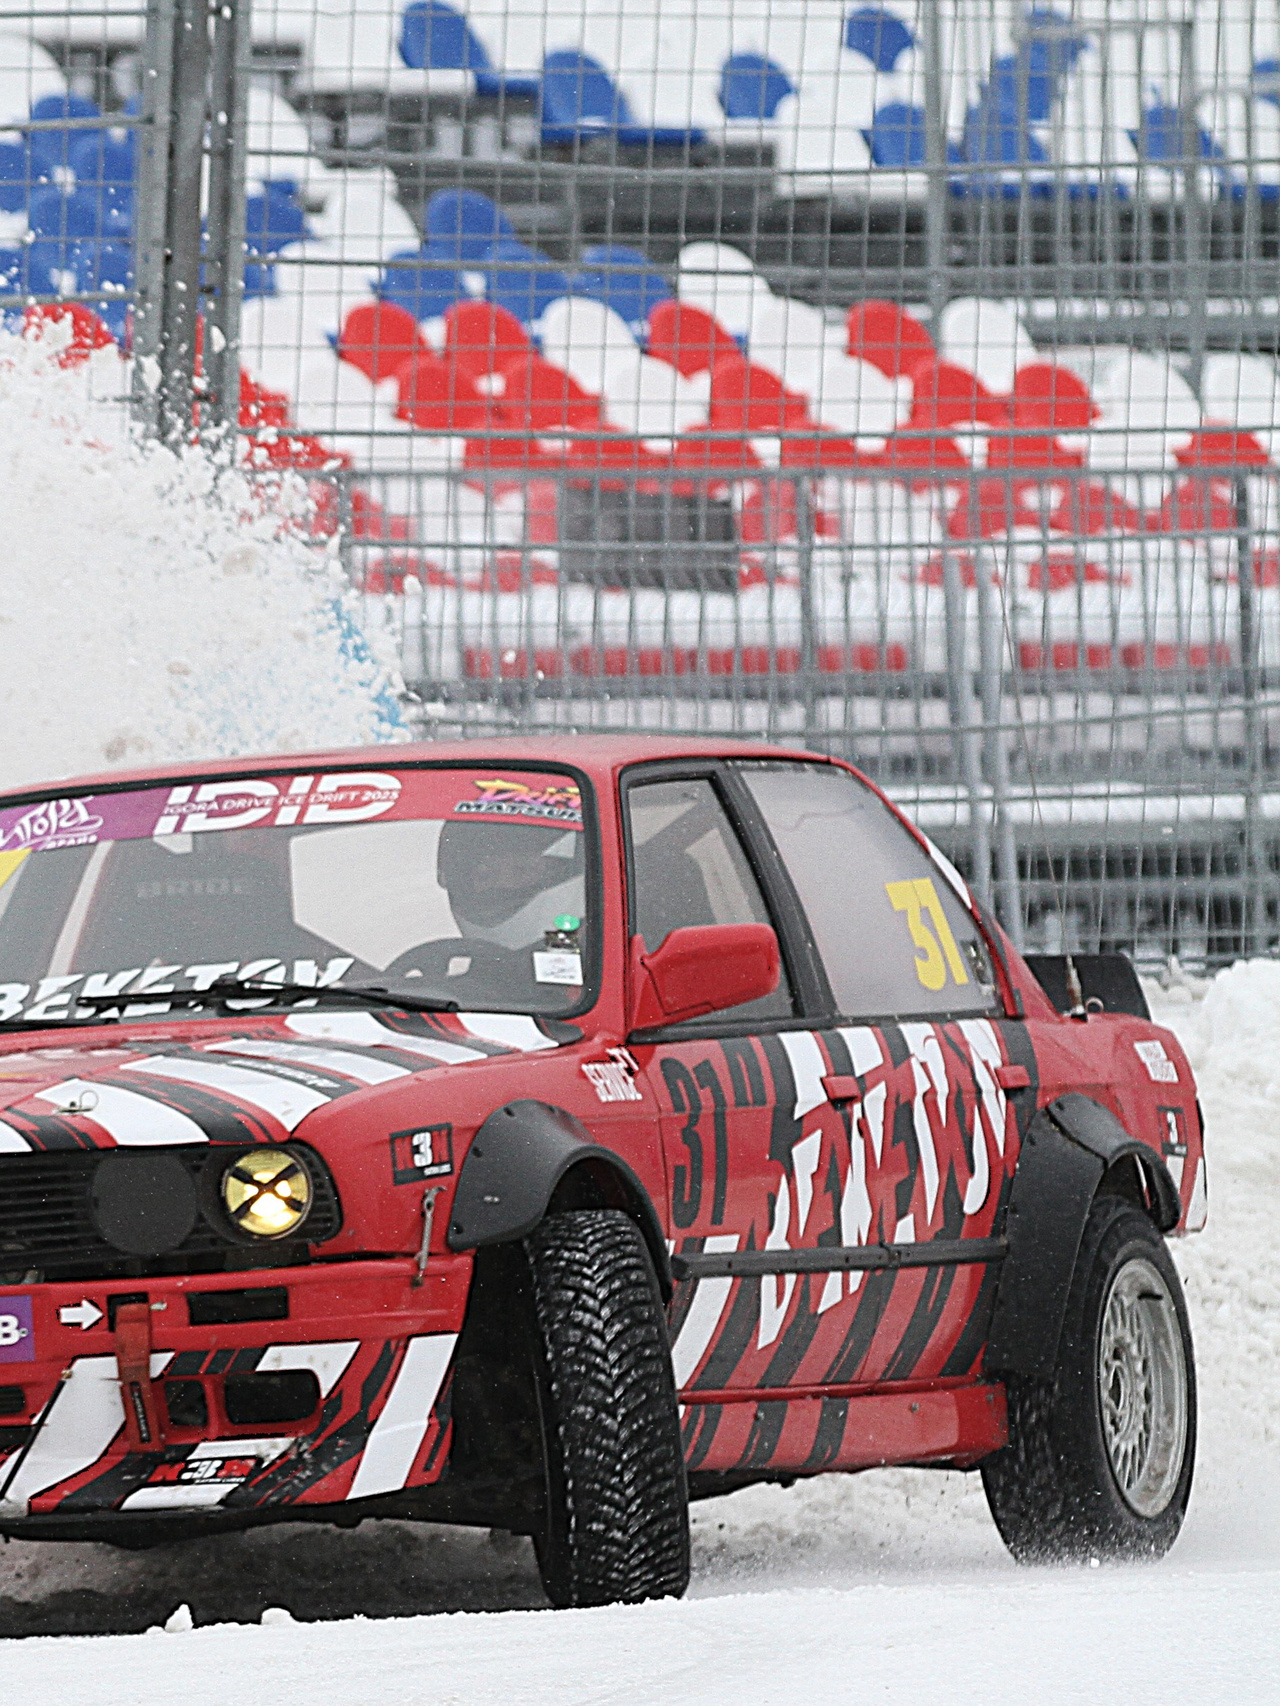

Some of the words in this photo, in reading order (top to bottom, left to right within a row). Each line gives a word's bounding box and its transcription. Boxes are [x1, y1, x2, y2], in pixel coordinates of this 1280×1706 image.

[163, 800, 219, 816] IGORA
[222, 796, 271, 812] DRIVE
[277, 792, 304, 806] ICE
[309, 790, 356, 804] DRIFT
[360, 789, 400, 802] 2025
[884, 877, 970, 992] 31
